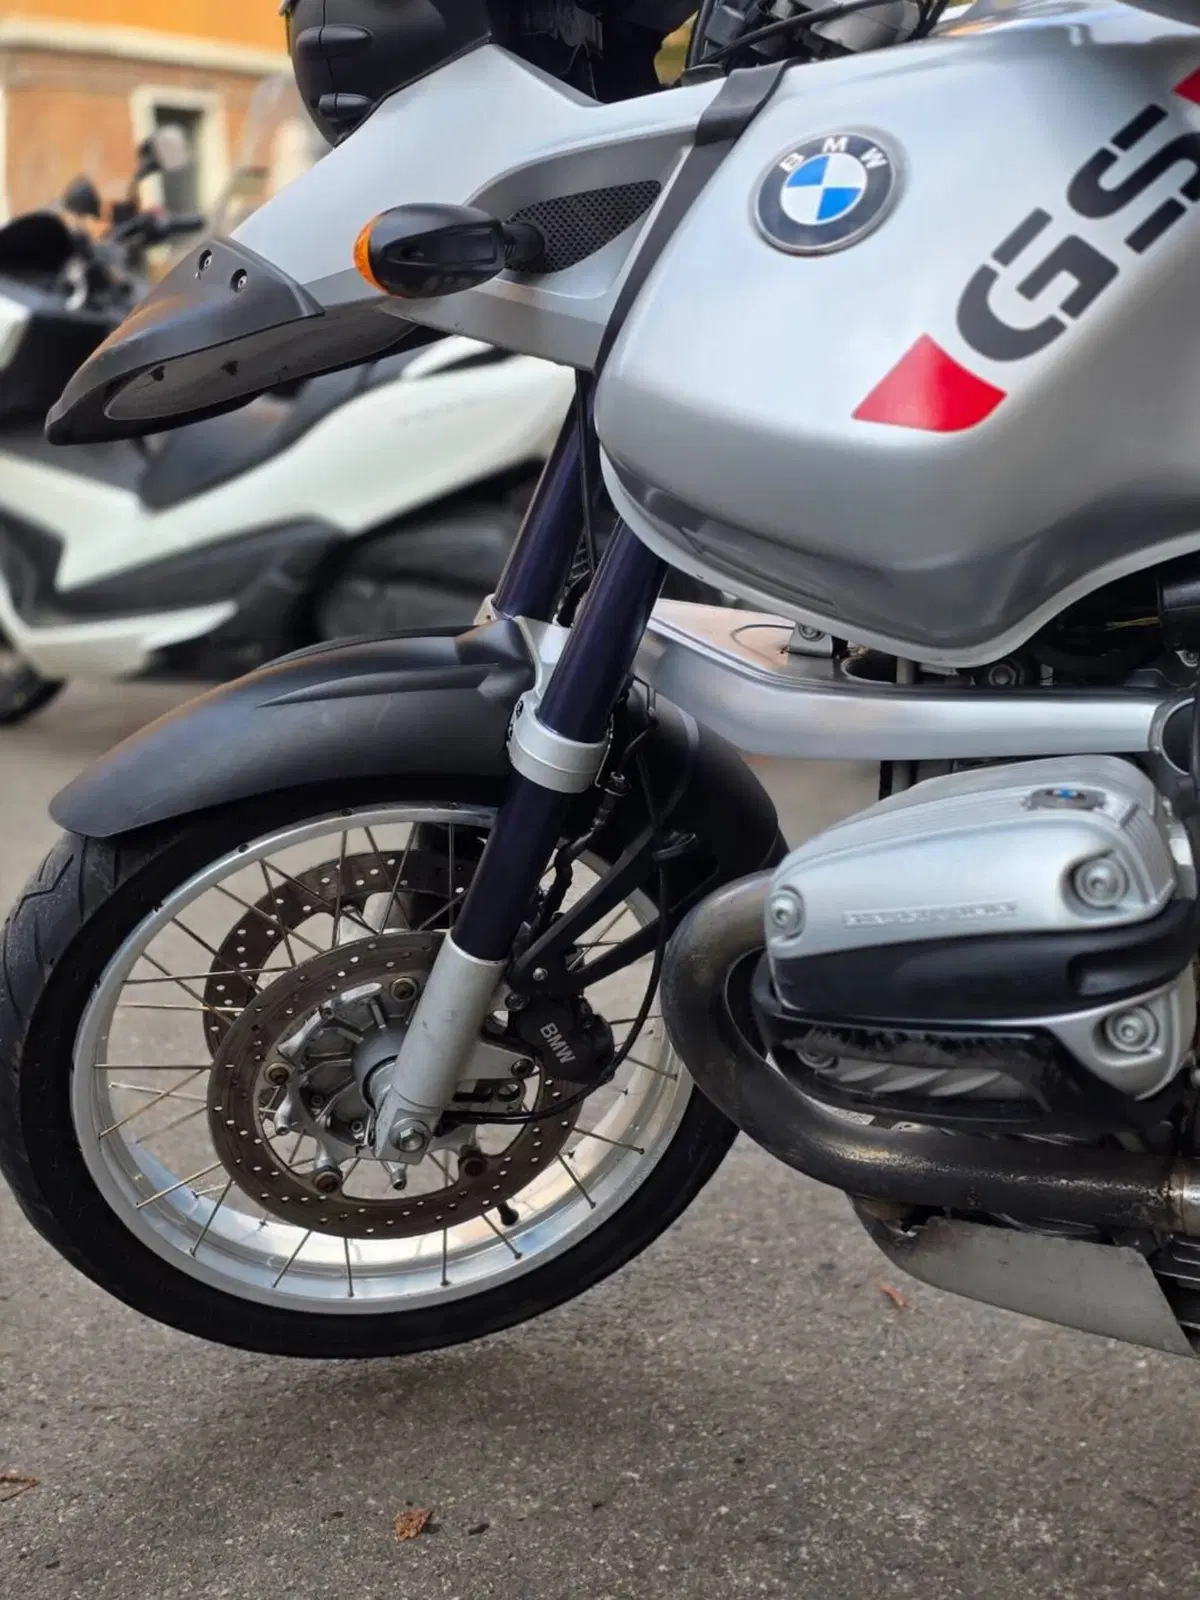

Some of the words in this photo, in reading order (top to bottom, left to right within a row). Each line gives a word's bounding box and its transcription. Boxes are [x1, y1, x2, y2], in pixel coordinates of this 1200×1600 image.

[779, 136, 889, 173] BMW
[956, 103, 1200, 363] GS
[540, 1022, 577, 1064] BMW
